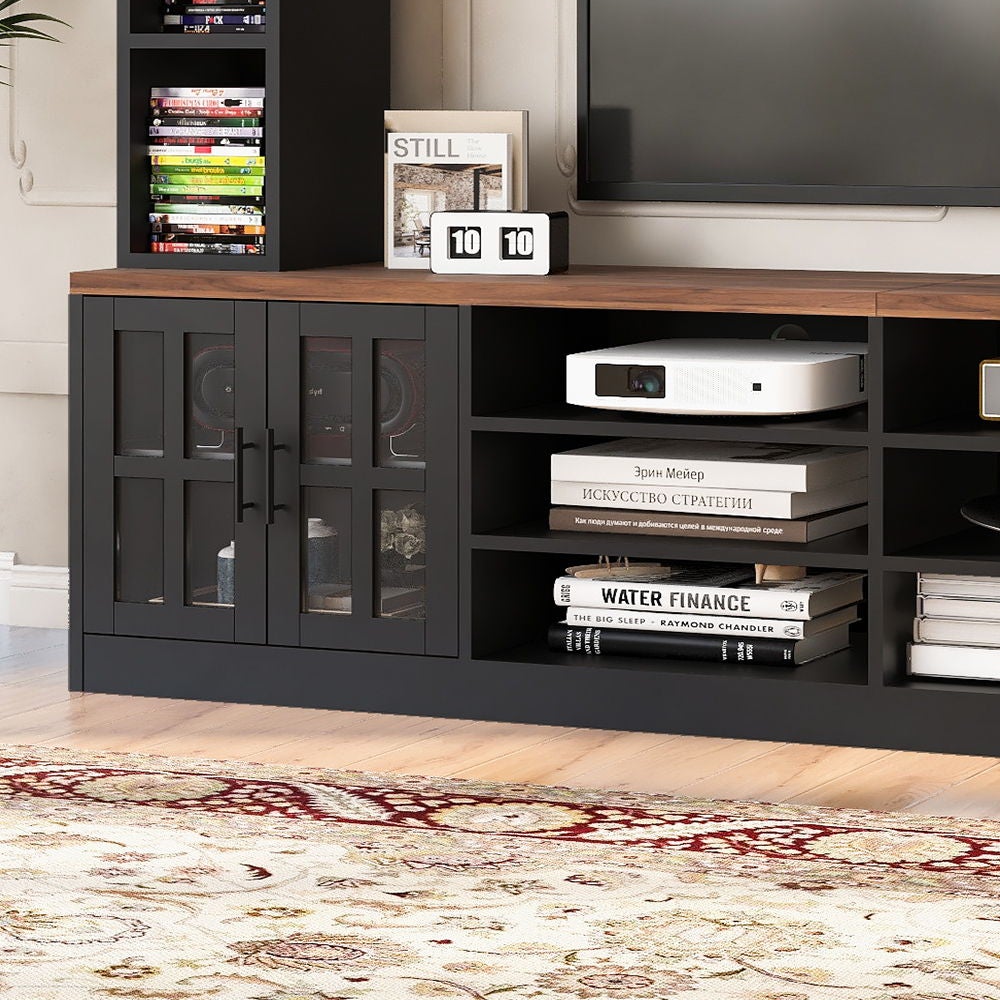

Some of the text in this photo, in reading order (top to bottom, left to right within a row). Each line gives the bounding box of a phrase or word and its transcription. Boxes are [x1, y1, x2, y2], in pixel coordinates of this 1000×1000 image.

[393, 138, 460, 158] STILL
[452, 229, 532, 256] 10 10
[633, 466, 705, 483] Эрин Мейер
[582, 488, 753, 510] ИСКУССТВО СТРАТЕГИИ
[575, 516, 587, 525] Как
[587, 518, 606, 527] люди
[606, 518, 632, 528] думают
[638, 520, 679, 530] добиваются
[679, 522, 700, 532] целей
[706, 524, 761, 535] международной
[762, 526, 784, 537] среде
[601, 587, 751, 612] WATER FINANCE
[573, 614, 775, 633] THE BIG SLEEP RAYMOND CHANDLER
[565, 629, 573, 652] ITALIAN
[593, 629, 601, 655] GARDENS
